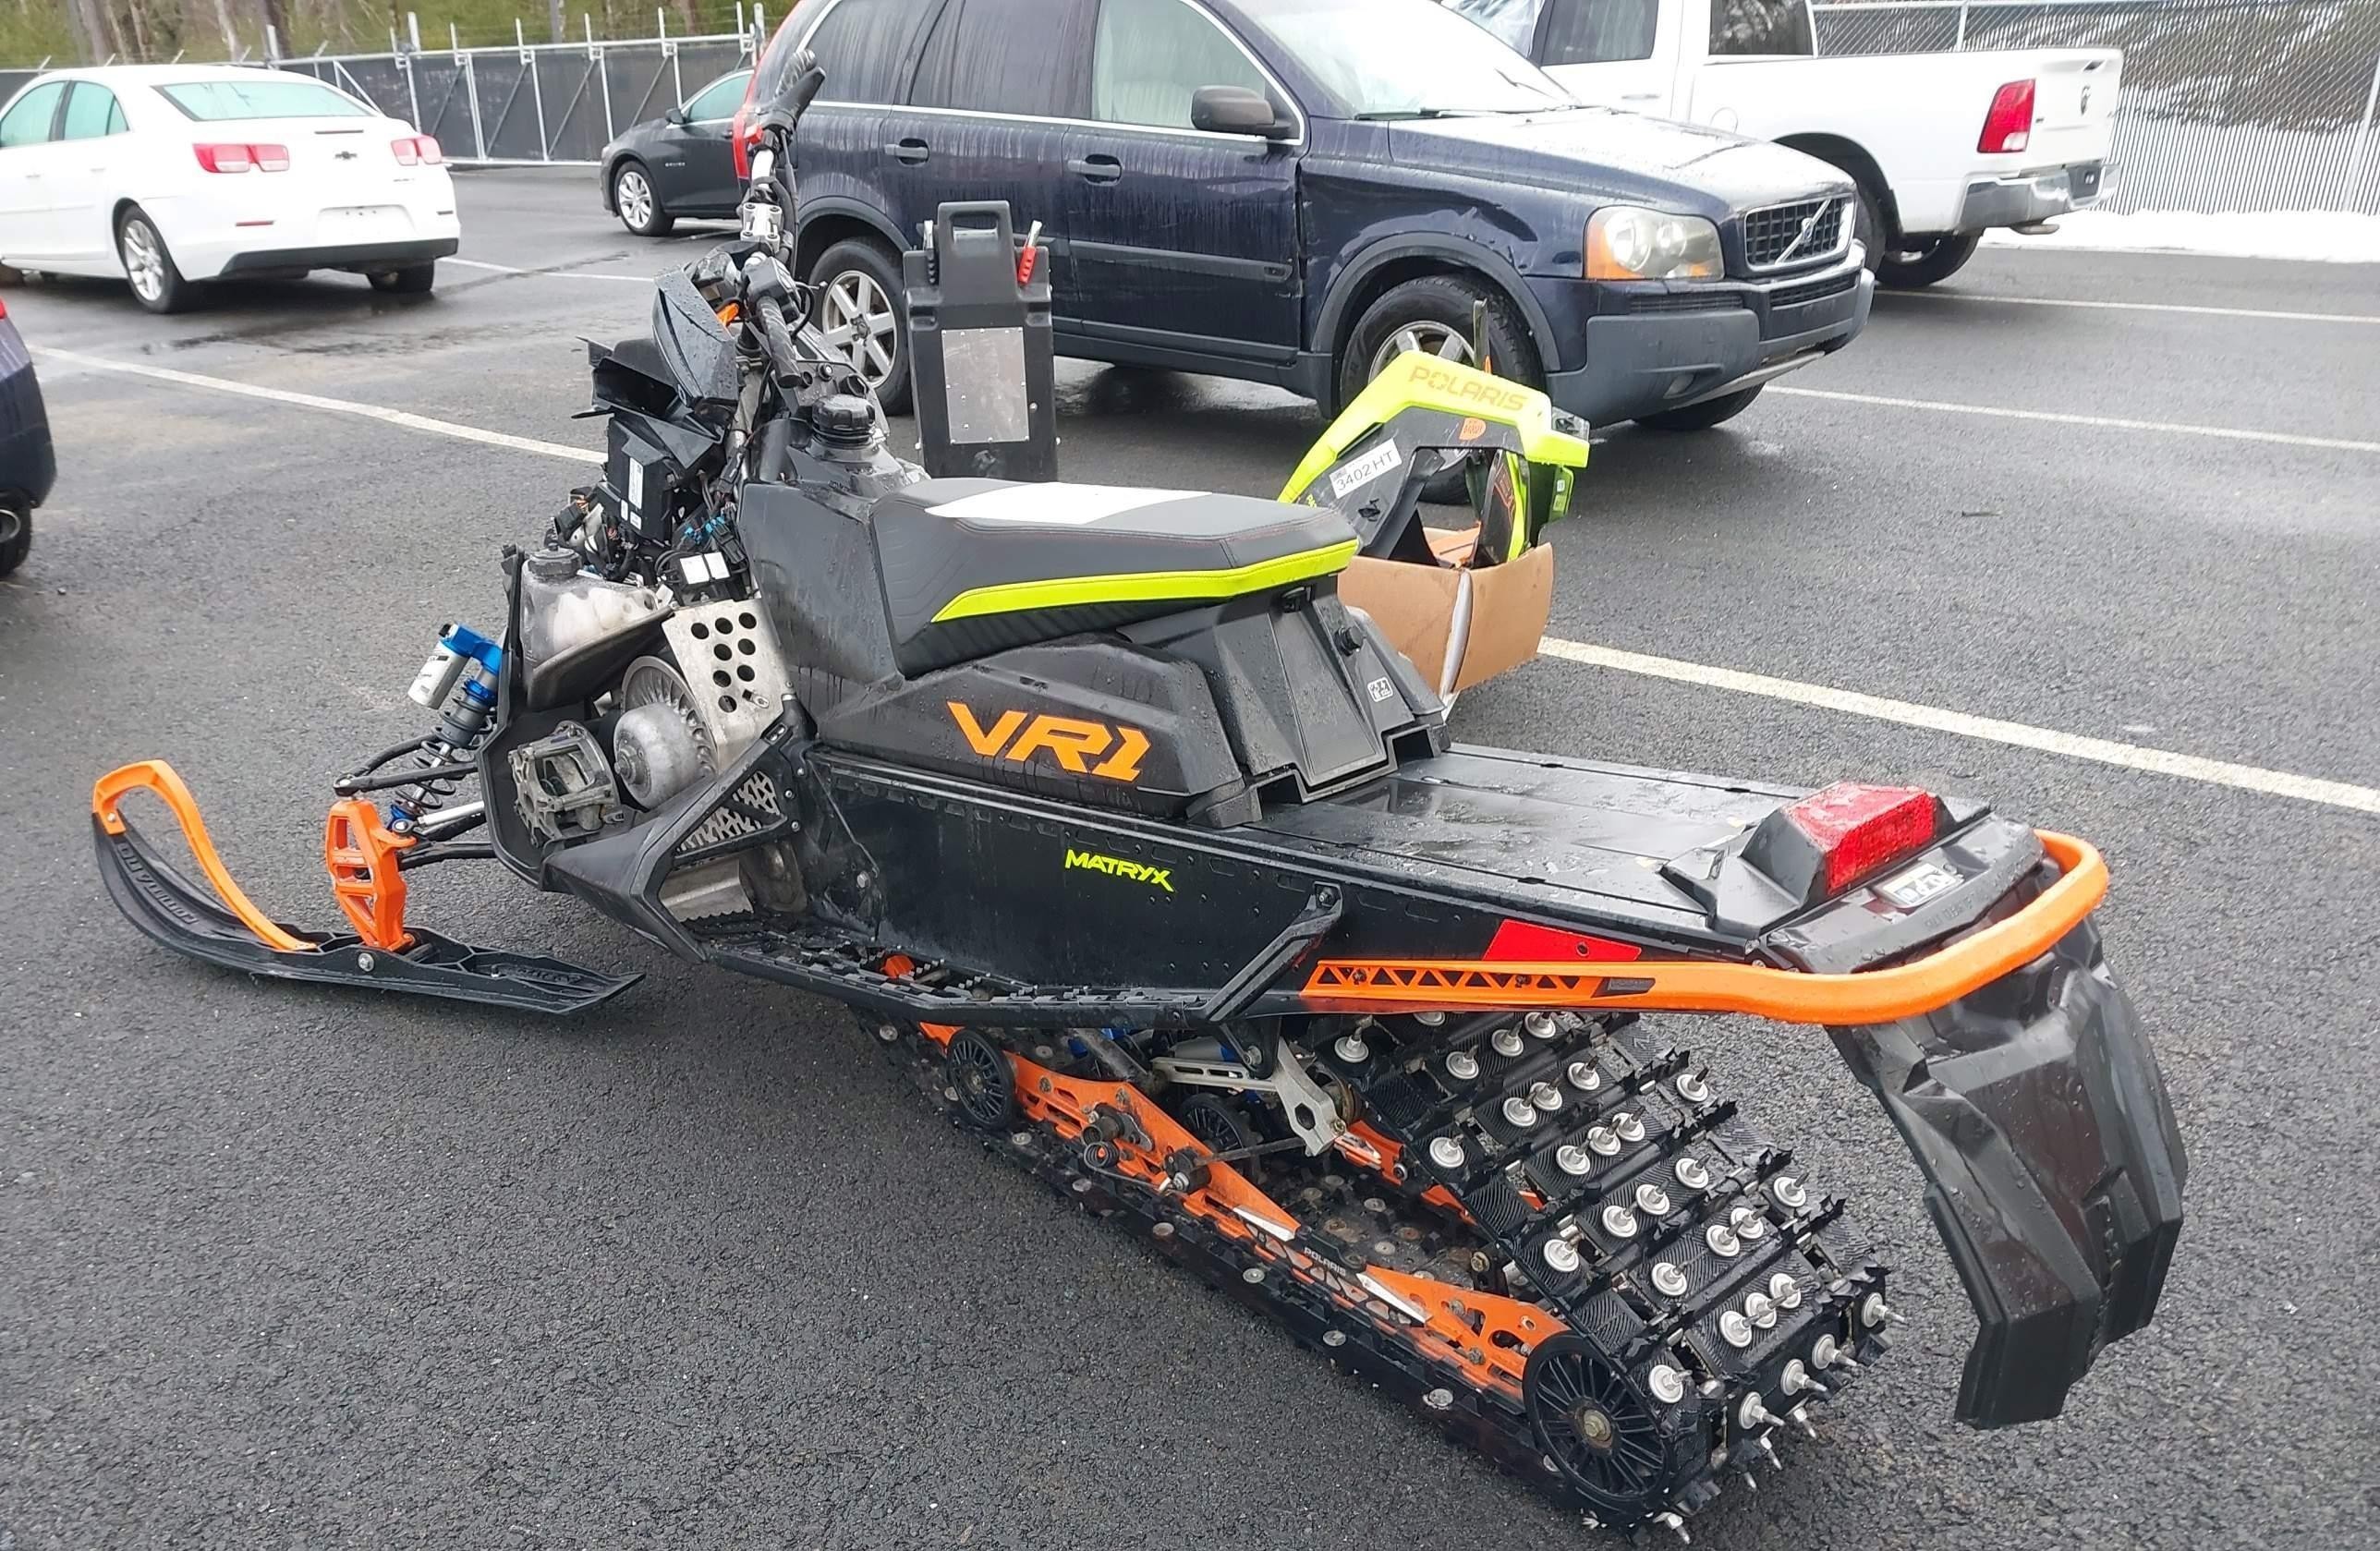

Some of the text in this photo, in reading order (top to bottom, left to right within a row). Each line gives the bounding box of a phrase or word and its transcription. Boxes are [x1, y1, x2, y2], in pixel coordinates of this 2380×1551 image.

[1408, 365, 1529, 412] POLARIS
[946, 701, 1152, 782] VR1
[1063, 848, 1178, 893] MATRYX
[1304, 1245, 1347, 1277] POLARIS
